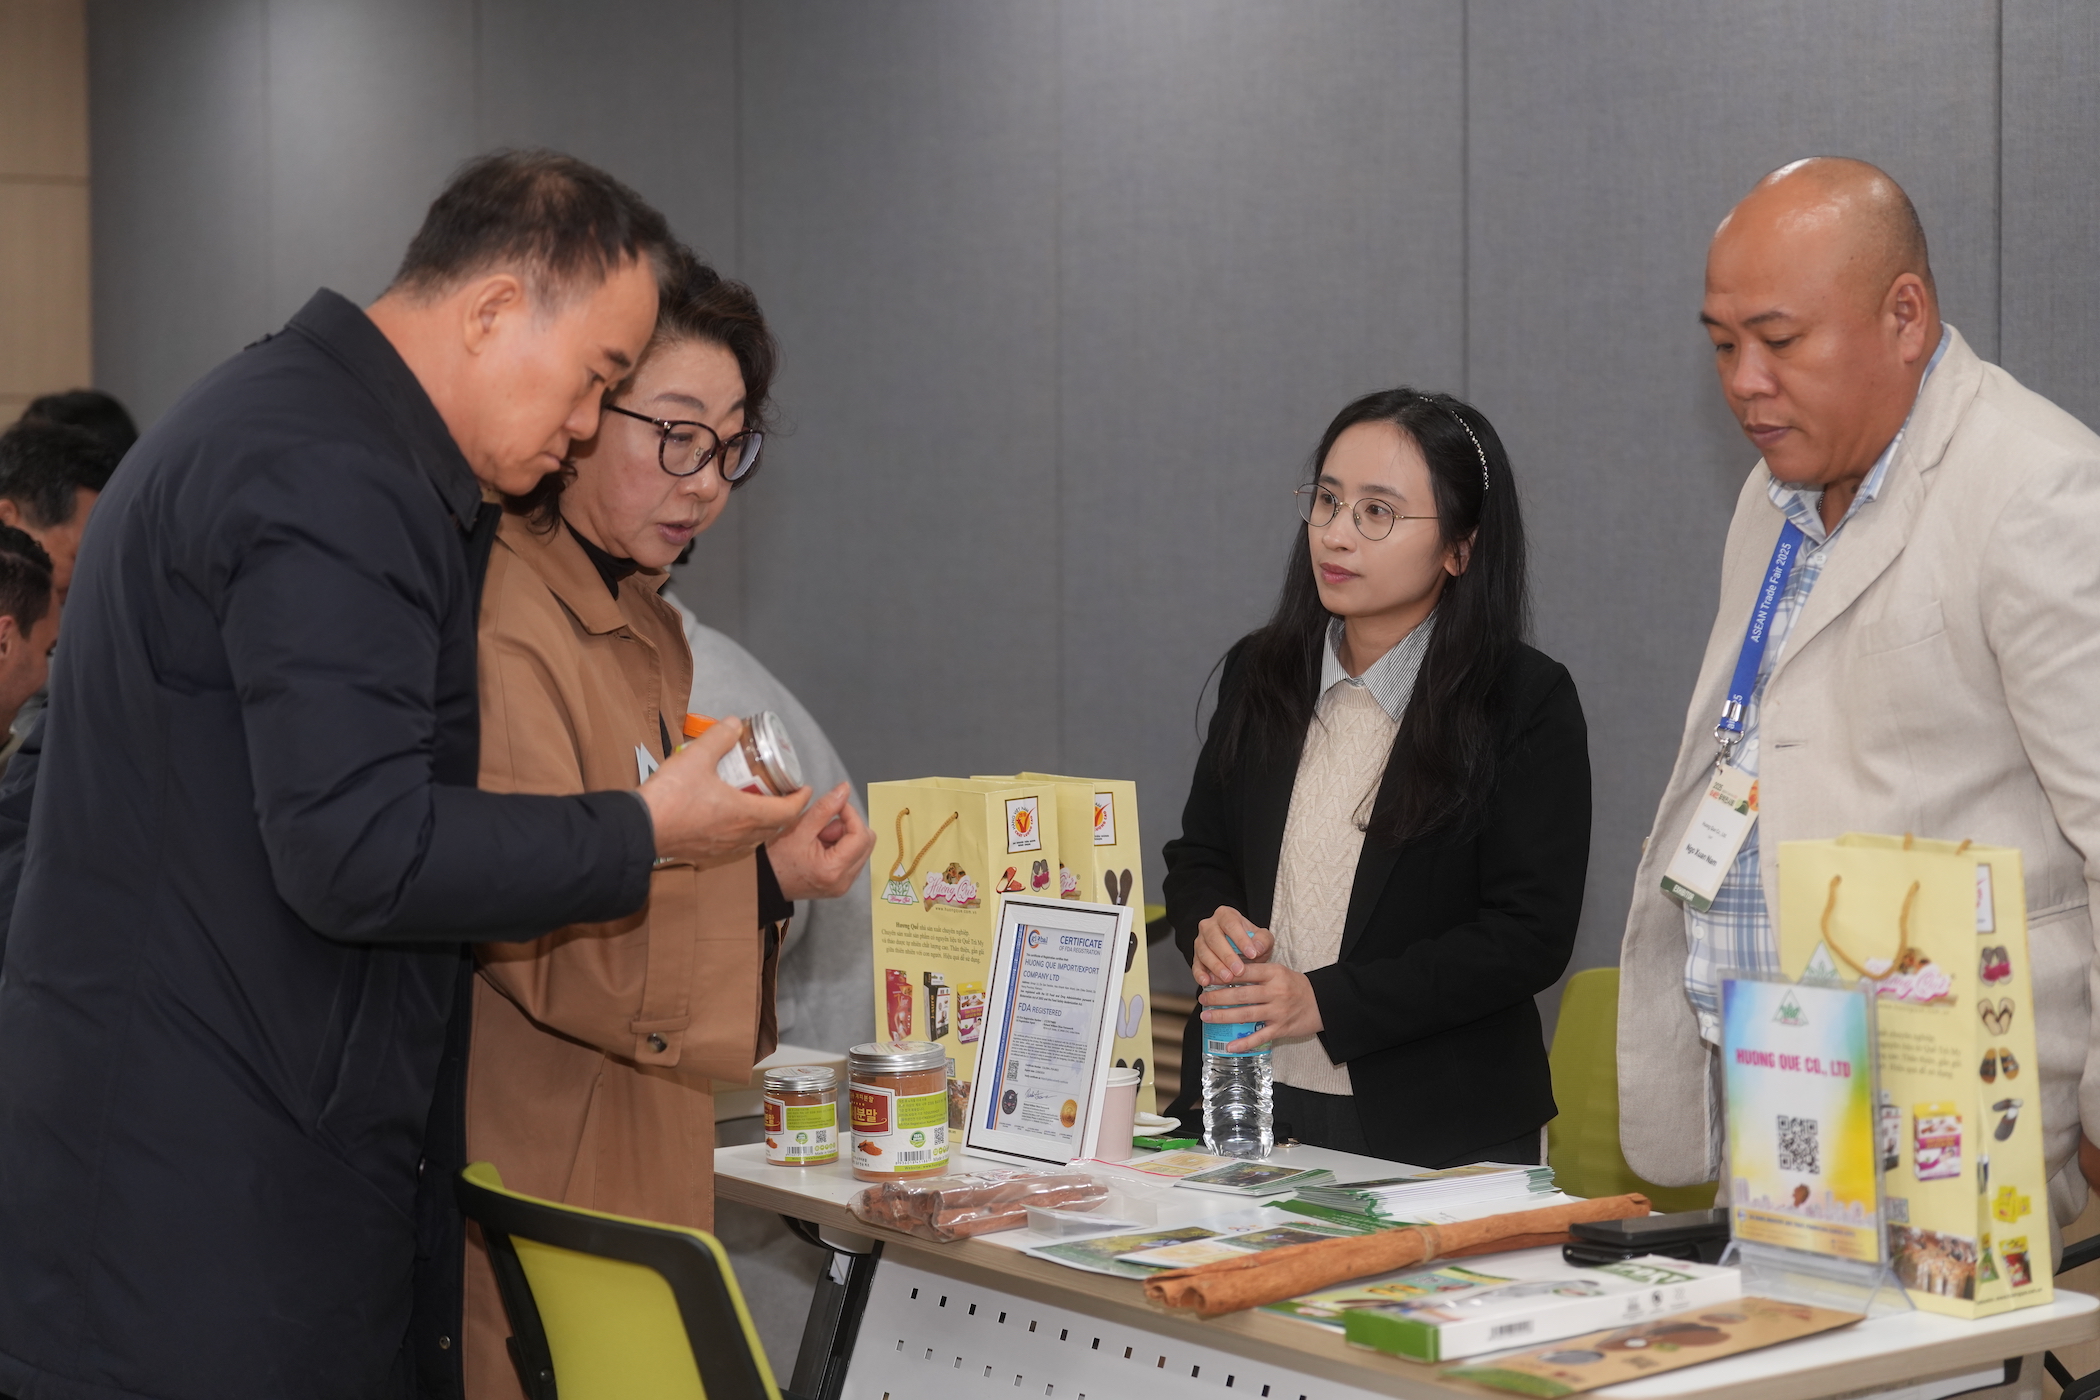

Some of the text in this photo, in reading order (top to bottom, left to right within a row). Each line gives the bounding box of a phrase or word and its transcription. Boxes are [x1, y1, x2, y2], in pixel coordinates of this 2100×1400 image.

[1750, 542, 1792, 643] ASEAN Trade Fair 2025
[1686, 843, 1717, 867] Ngo Xuan Nam
[1672, 884, 1694, 901] EXHIBITOR
[1060, 935, 1102, 949] CERTIFICATE
[1073, 947, 1100, 955] REGISTRATION
[1023, 970, 1049, 980] COMPANY
[1025, 959, 1099, 975] HUONG QUE IMPORT/EXPORT
[1018, 1002, 1062, 1016] FDA REGISTERED
[1736, 1048, 1851, 1078] HUONG QUE CO., LTD
